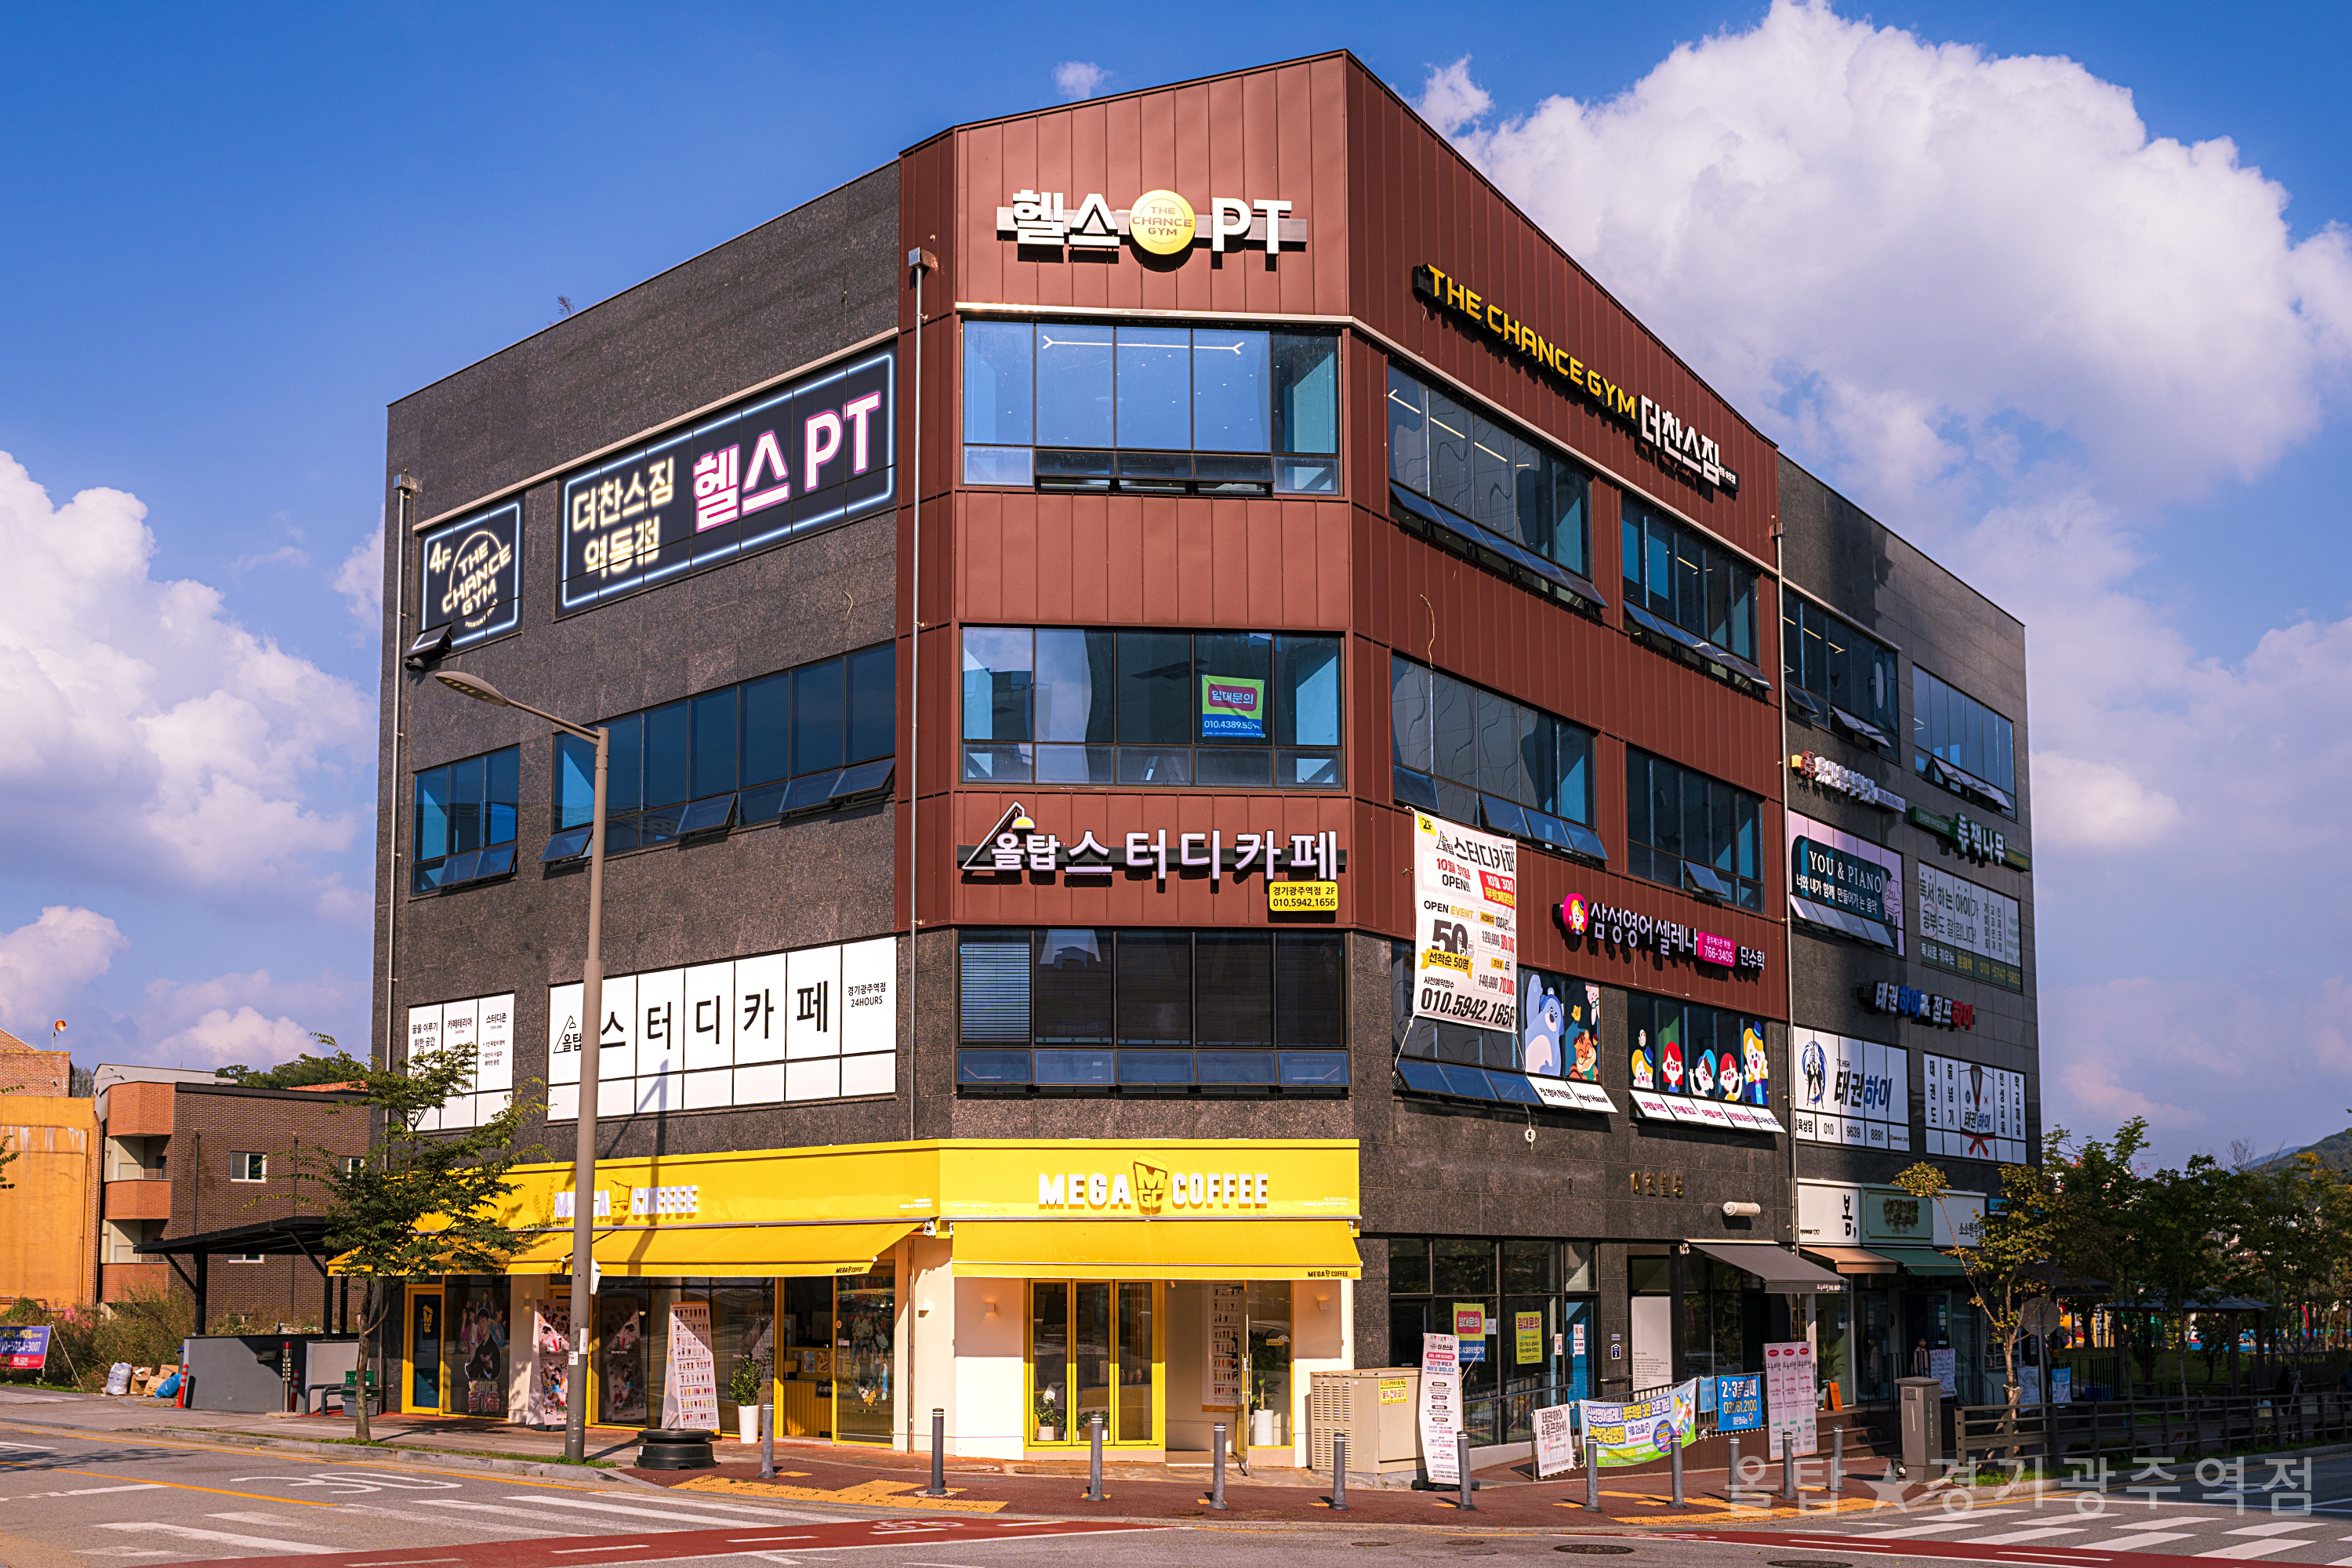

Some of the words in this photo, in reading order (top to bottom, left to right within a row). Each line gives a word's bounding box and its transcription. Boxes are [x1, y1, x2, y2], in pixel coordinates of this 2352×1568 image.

[1012, 190, 1120, 246] 헬스
[1212, 198, 1292, 254] PT
[1132, 216, 1192, 227] CHANCE
[1148, 227, 1177, 236] GYM
[1427, 263, 1483, 320] THE
[1486, 304, 1584, 386] CHANCE
[1587, 369, 1635, 419] GYM
[1640, 394, 1720, 486] 더찬스짐
[573, 458, 674, 533] 더찬스짐
[694, 432, 789, 532] 헬스
[805, 392, 880, 490] PT
[430, 542, 452, 573] 4F
[458, 540, 488, 576] THE
[584, 517, 659, 578] 역동점
[441, 543, 511, 613] CHANCE
[463, 578, 496, 616] GYM
[1211, 690, 1254, 704] 임대문의
[1930, 818, 1940, 829] SINCE
[1970, 821, 2005, 866] 책나무
[991, 833, 1060, 871] 올탑
[1065, 829, 1338, 880] 스터디카페
[1436, 858, 1456, 873] 10월
[1457, 864, 1471, 880] 31일
[1809, 851, 1834, 876] YOU
[1838, 862, 1845, 880] &
[1848, 866, 1882, 893] PIANO
[1272, 886, 1322, 897] 경기광주역점
[1325, 887, 1335, 895] 2F
[1796, 874, 1808, 891] 너와
[1809, 878, 1822, 895] 내가
[1823, 882, 1835, 900] 함께
[1837, 887, 1865, 910] 만들어가는
[1867, 898, 1877, 914] 음악
[1919, 878, 1934, 904] 독서
[1937, 886, 1953, 911] 하는
[1955, 893, 1979, 920] 아이가
[1272, 898, 1336, 908] 010.5942.1656
[1424, 901, 1449, 913] OPEN
[1450, 906, 1474, 919] EVENT
[1591, 902, 1652, 948] 삼성영어
[1655, 920, 1698, 955] 셀레나
[1947, 918, 1954, 938] 잘
[1955, 921, 1977, 945] 합니다!
[1429, 952, 1452, 966] 선착순
[1454, 958, 1468, 970] 50명
[1704, 946, 1733, 963] 766-3405
[1740, 946, 1765, 970] 단수학
[1922, 942, 1937, 960] 독서로
[1980, 962, 1991, 975] 010
[1424, 976, 1454, 989] 사전예약접수
[851, 995, 884, 1007] 24HOURS
[1421, 988, 1515, 1027] 010.5942.1656
[447, 1017, 472, 1029] 카페테리아
[486, 1013, 506, 1024] 스터디존
[600, 980, 829, 1051] 스터디카페
[848, 982, 887, 996] 경기광주역점
[412, 1024, 422, 1034] 꿈을
[423, 1022, 437, 1033] 이루기
[426, 1036, 435, 1047] 공간
[1577, 1093, 1592, 1103] Hey!
[1835, 1070, 1893, 1112] 태권하이
[1795, 1119, 1813, 1133] 육상담
[1824, 1123, 1834, 1135] 010
[1846, 1126, 1860, 1138] 9639
[1871, 1129, 1883, 1141] 8891
[1964, 1111, 1991, 1131] 태권하이
[631, 1185, 698, 1215] COFFEE
[1039, 1173, 1131, 1206] MEGA
[1172, 1173, 1268, 1204] COFFEE
[1458, 1317, 1480, 1327] 임대문의
[1518, 1317, 1540, 1330] 임대문의
[468, 1392, 499, 1411] 즐거움
[1651, 1396, 1671, 1415] 오픈기념
[1628, 1426, 1635, 1436] 9월
[1635, 1425, 1645, 1435] 26일
[230, 1472, 463, 1494] 30
